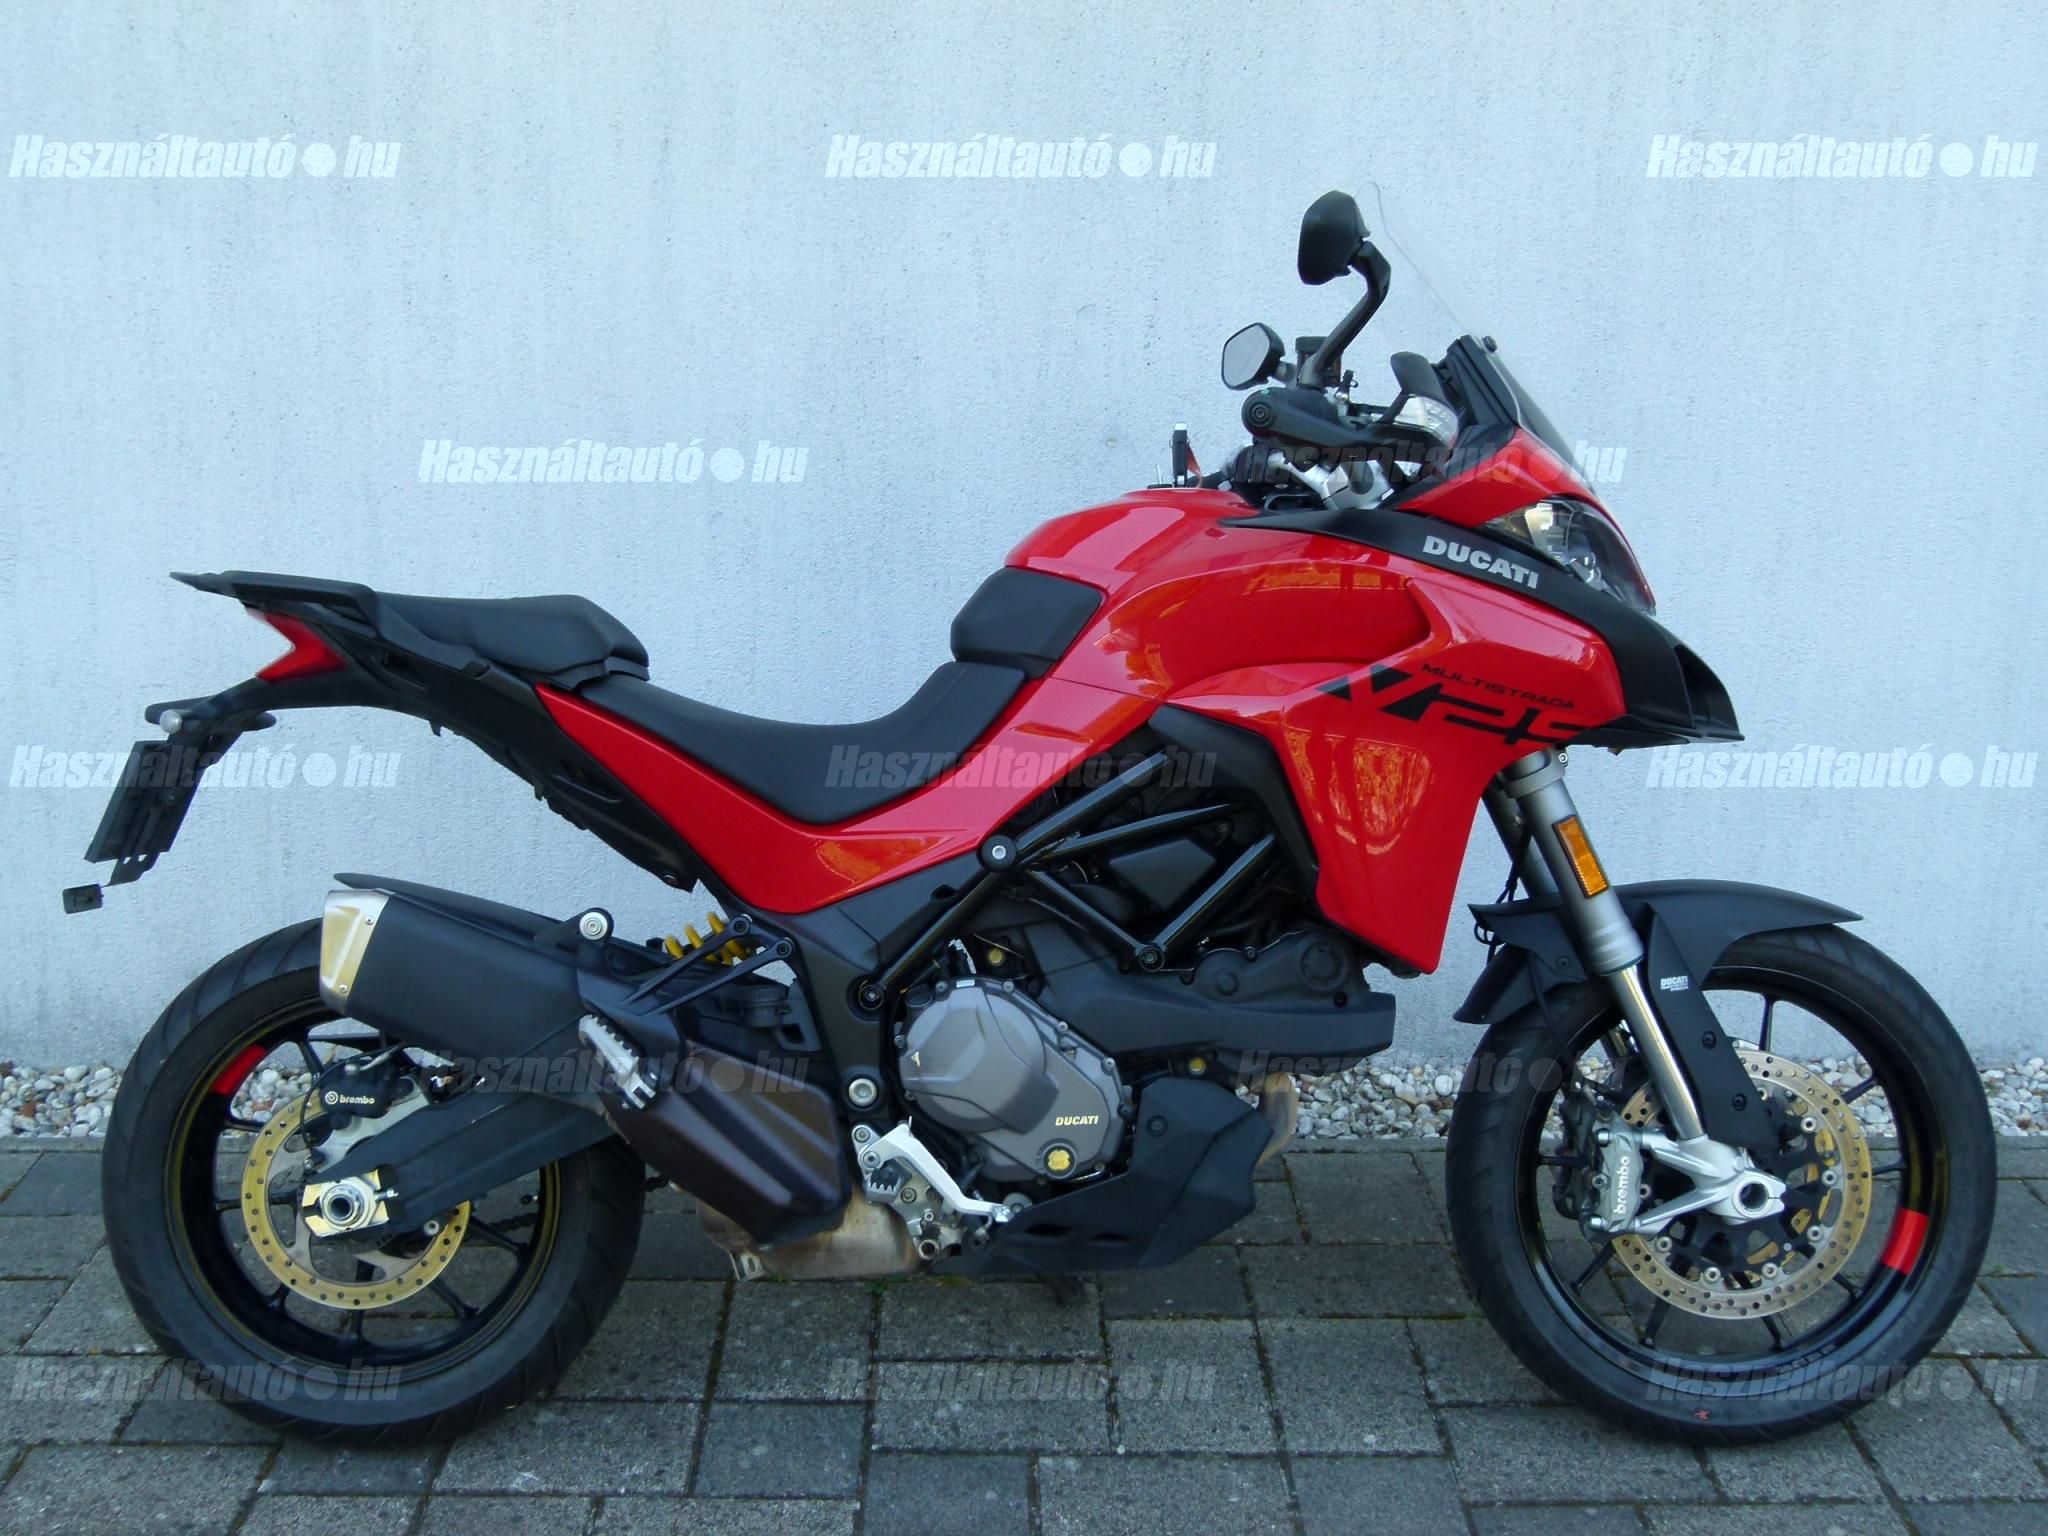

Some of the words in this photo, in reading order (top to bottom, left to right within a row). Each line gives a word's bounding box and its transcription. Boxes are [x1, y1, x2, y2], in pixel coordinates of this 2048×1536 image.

[1422, 535, 1538, 589] DUCATI
[1421, 663, 1575, 710] MULTISTRADA
[1660, 975, 1688, 987] DUCATI
[339, 1094, 375, 1104] brembo
[1055, 1115, 1099, 1126] DUCATI
[1613, 1156, 1630, 1214] brembo
